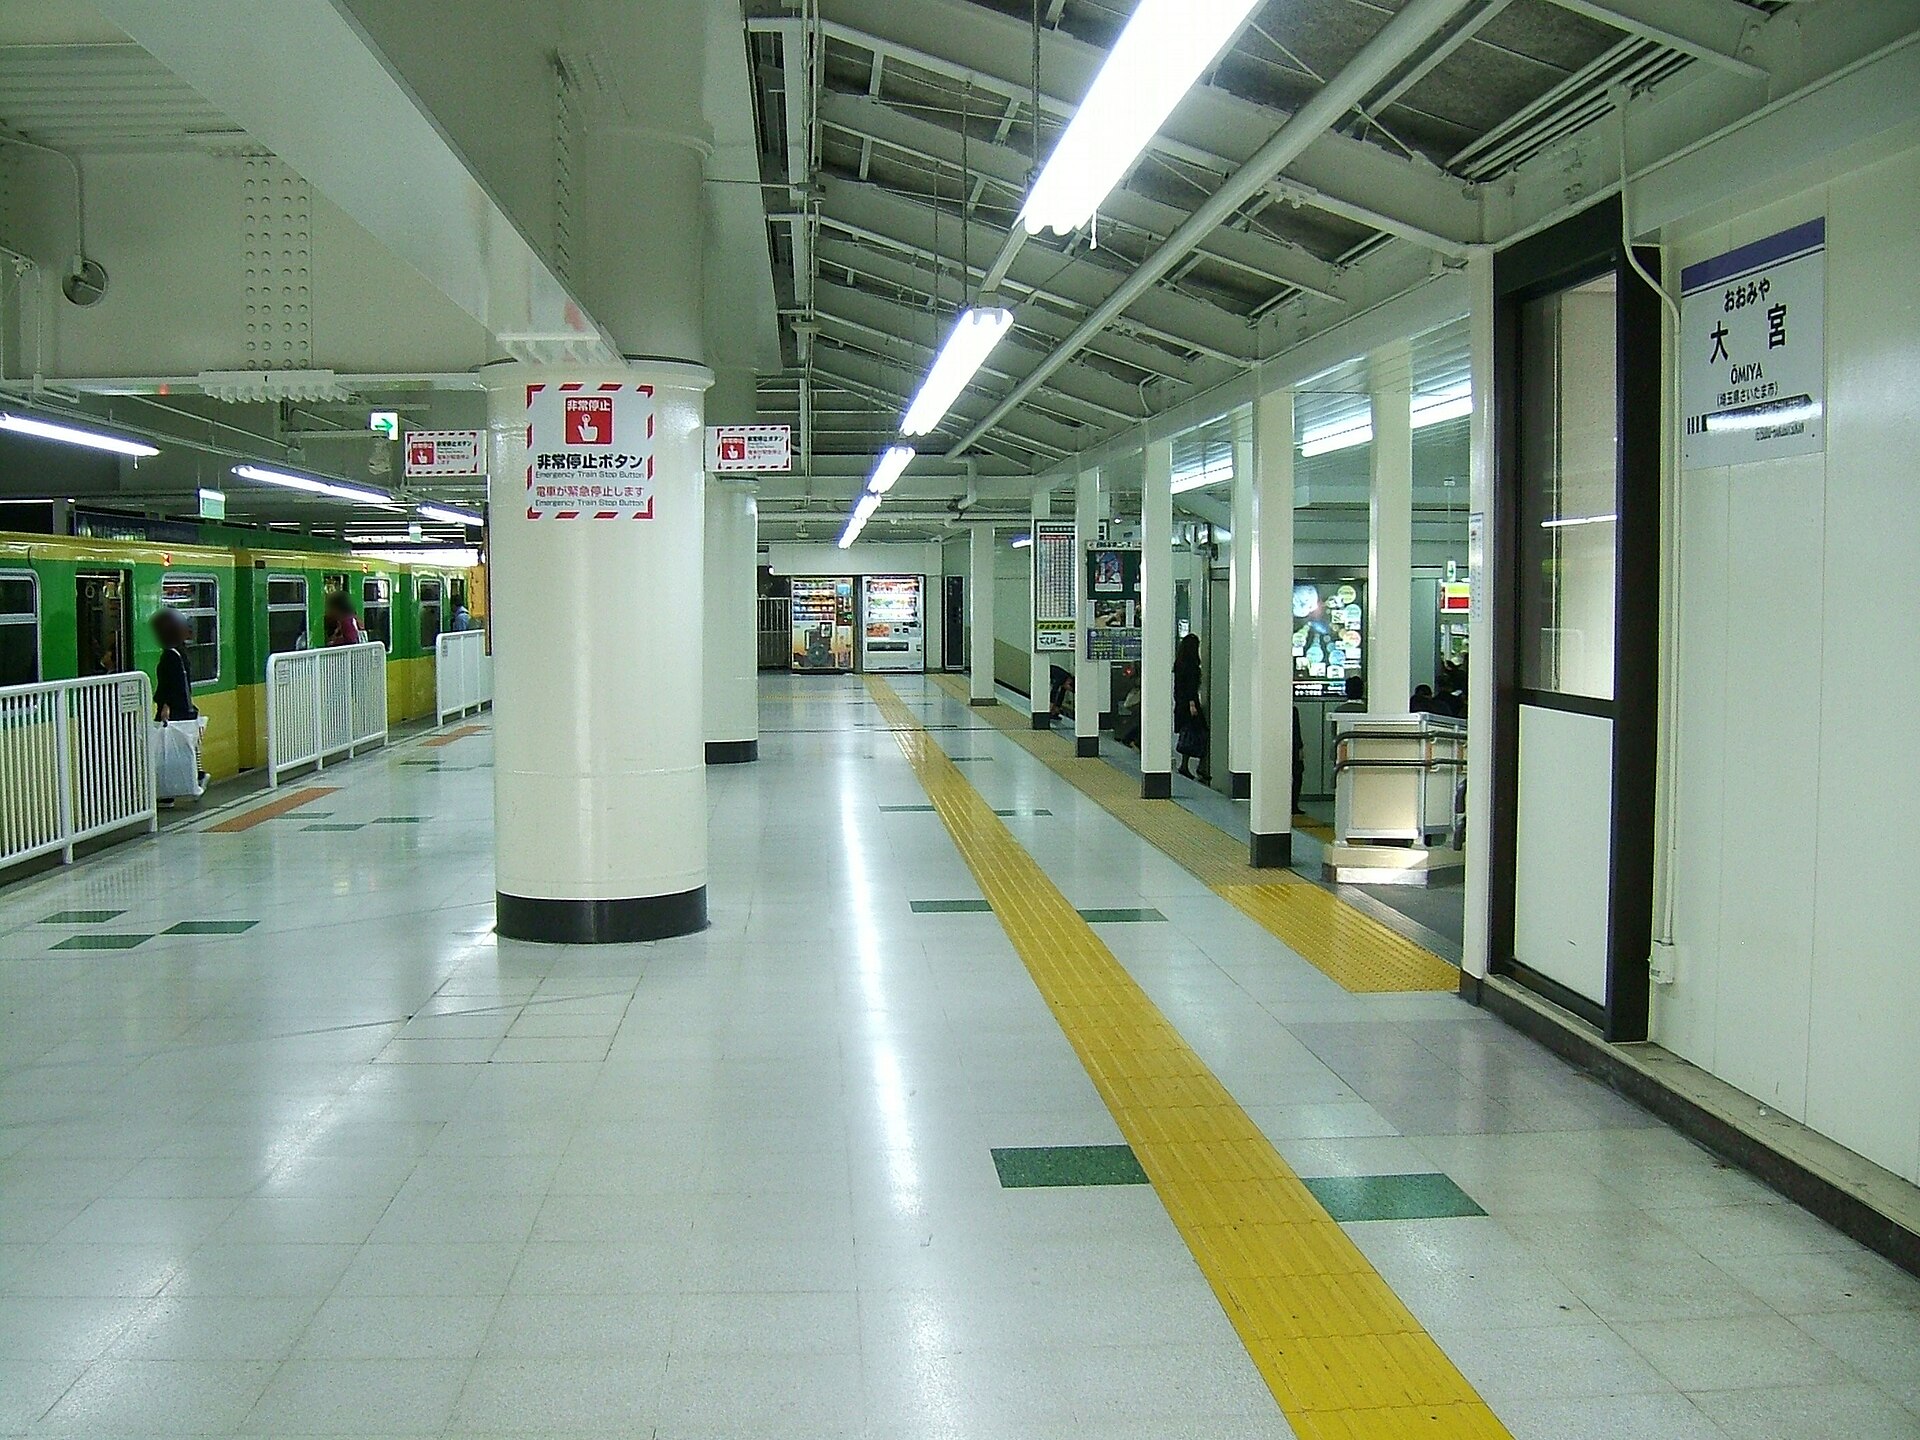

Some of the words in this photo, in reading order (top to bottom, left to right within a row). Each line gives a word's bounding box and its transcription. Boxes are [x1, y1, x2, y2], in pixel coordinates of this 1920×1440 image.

[1724, 277, 1770, 313] おおみや
[567, 400, 611, 412] 非常停止
[537, 453, 643, 470] 非常停止ボタン
[535, 471, 575, 479] Emergency
[599, 471, 617, 479] Stop
[536, 486, 644, 497] 電車が緊急停止します
[535, 499, 575, 507] Emergency
